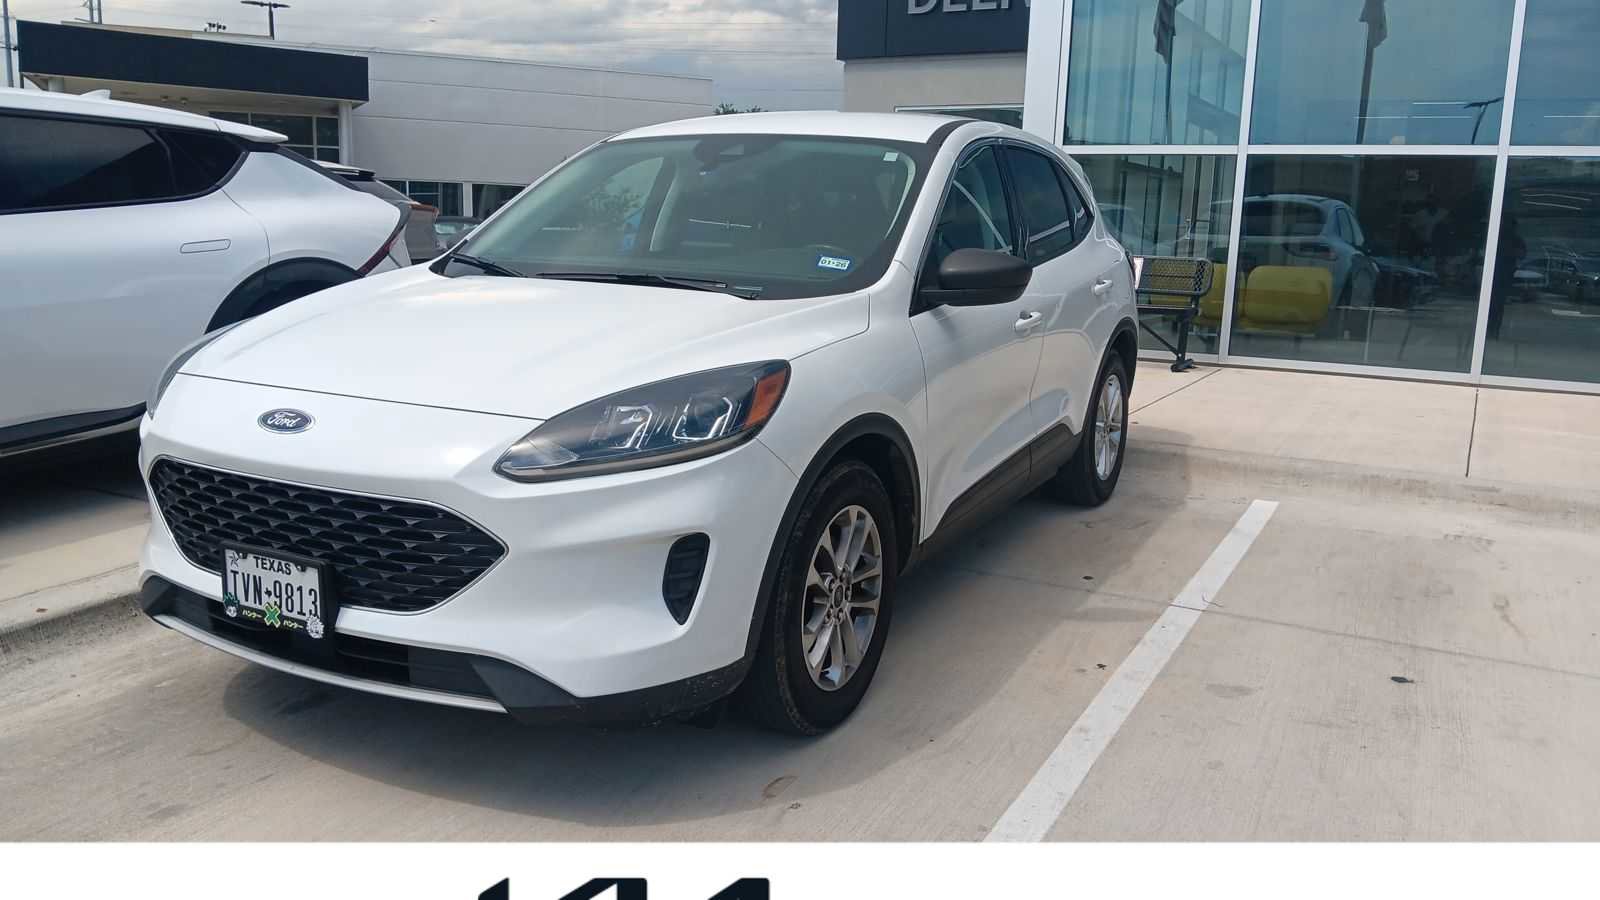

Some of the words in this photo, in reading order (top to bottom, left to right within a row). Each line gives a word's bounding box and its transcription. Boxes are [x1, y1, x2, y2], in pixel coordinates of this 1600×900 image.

[266, 411, 302, 428] Ford
[252, 555, 292, 576] TEXAS
[273, 580, 319, 618] 9813
